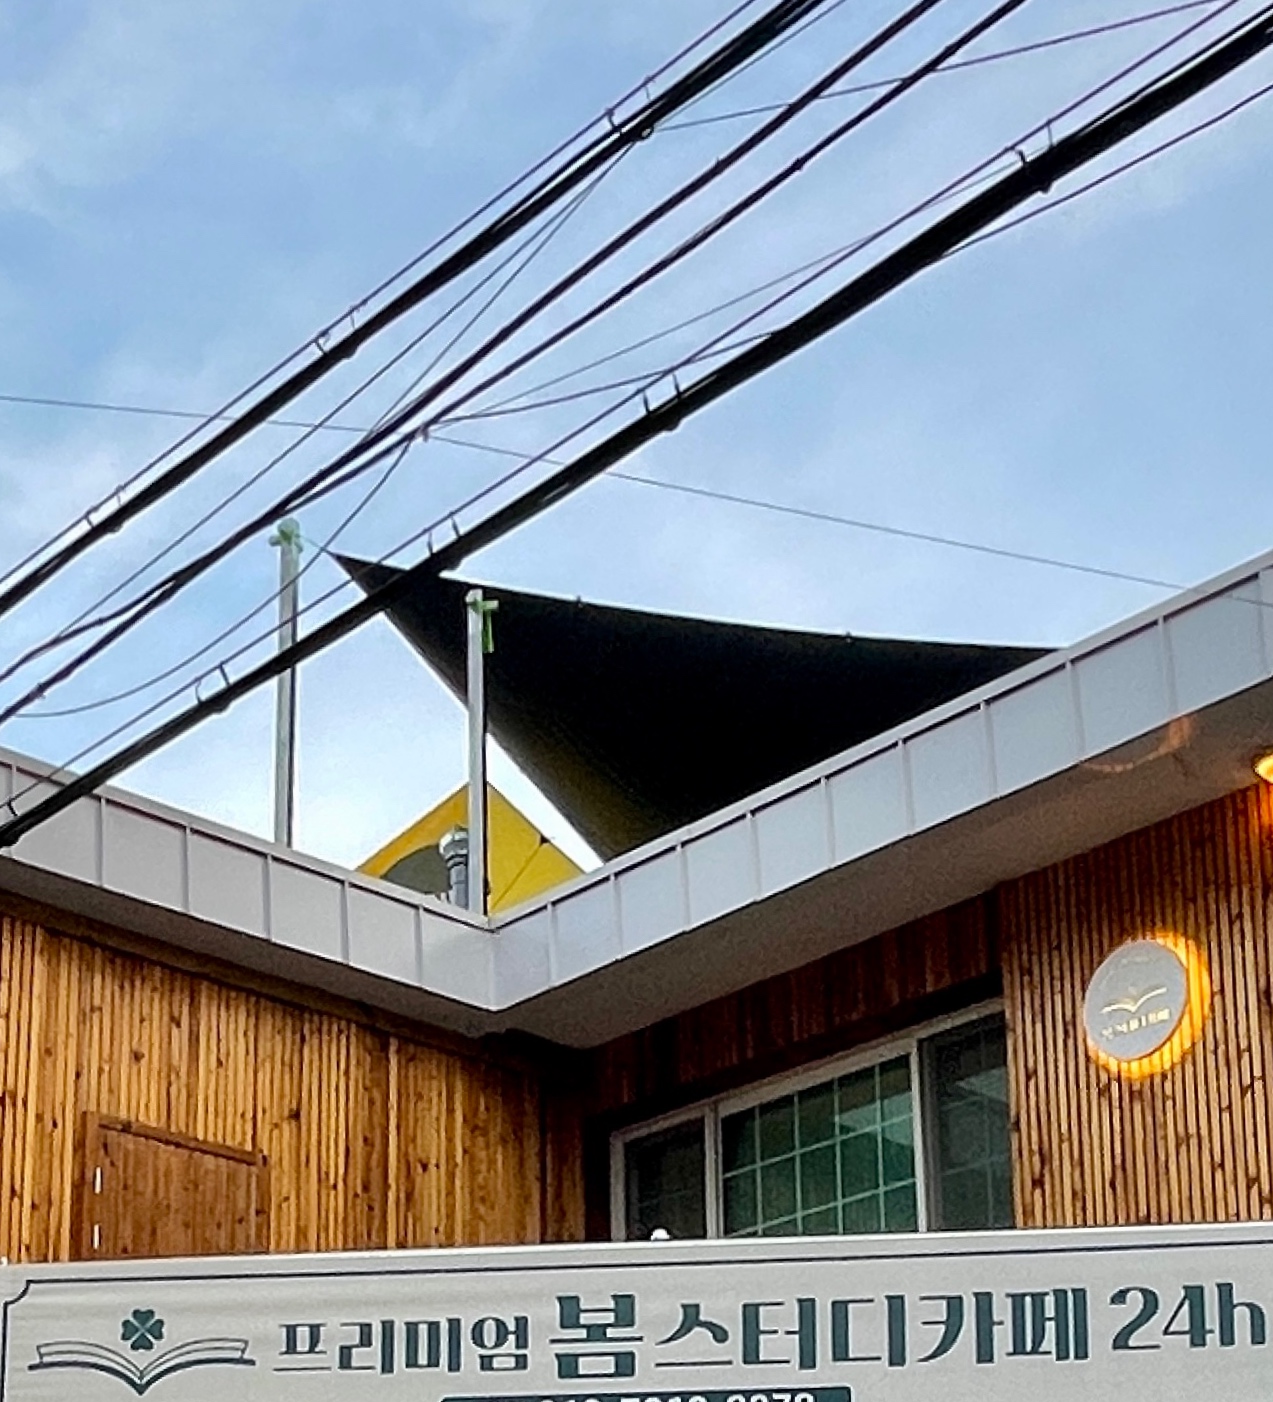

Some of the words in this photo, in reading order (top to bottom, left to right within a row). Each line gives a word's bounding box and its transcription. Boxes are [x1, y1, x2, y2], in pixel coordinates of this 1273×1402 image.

[272, 1313, 530, 1377] 프리미엄
[547, 1285, 1092, 1380] 봄스터디카페
[1109, 1281, 1268, 1353] 24h
